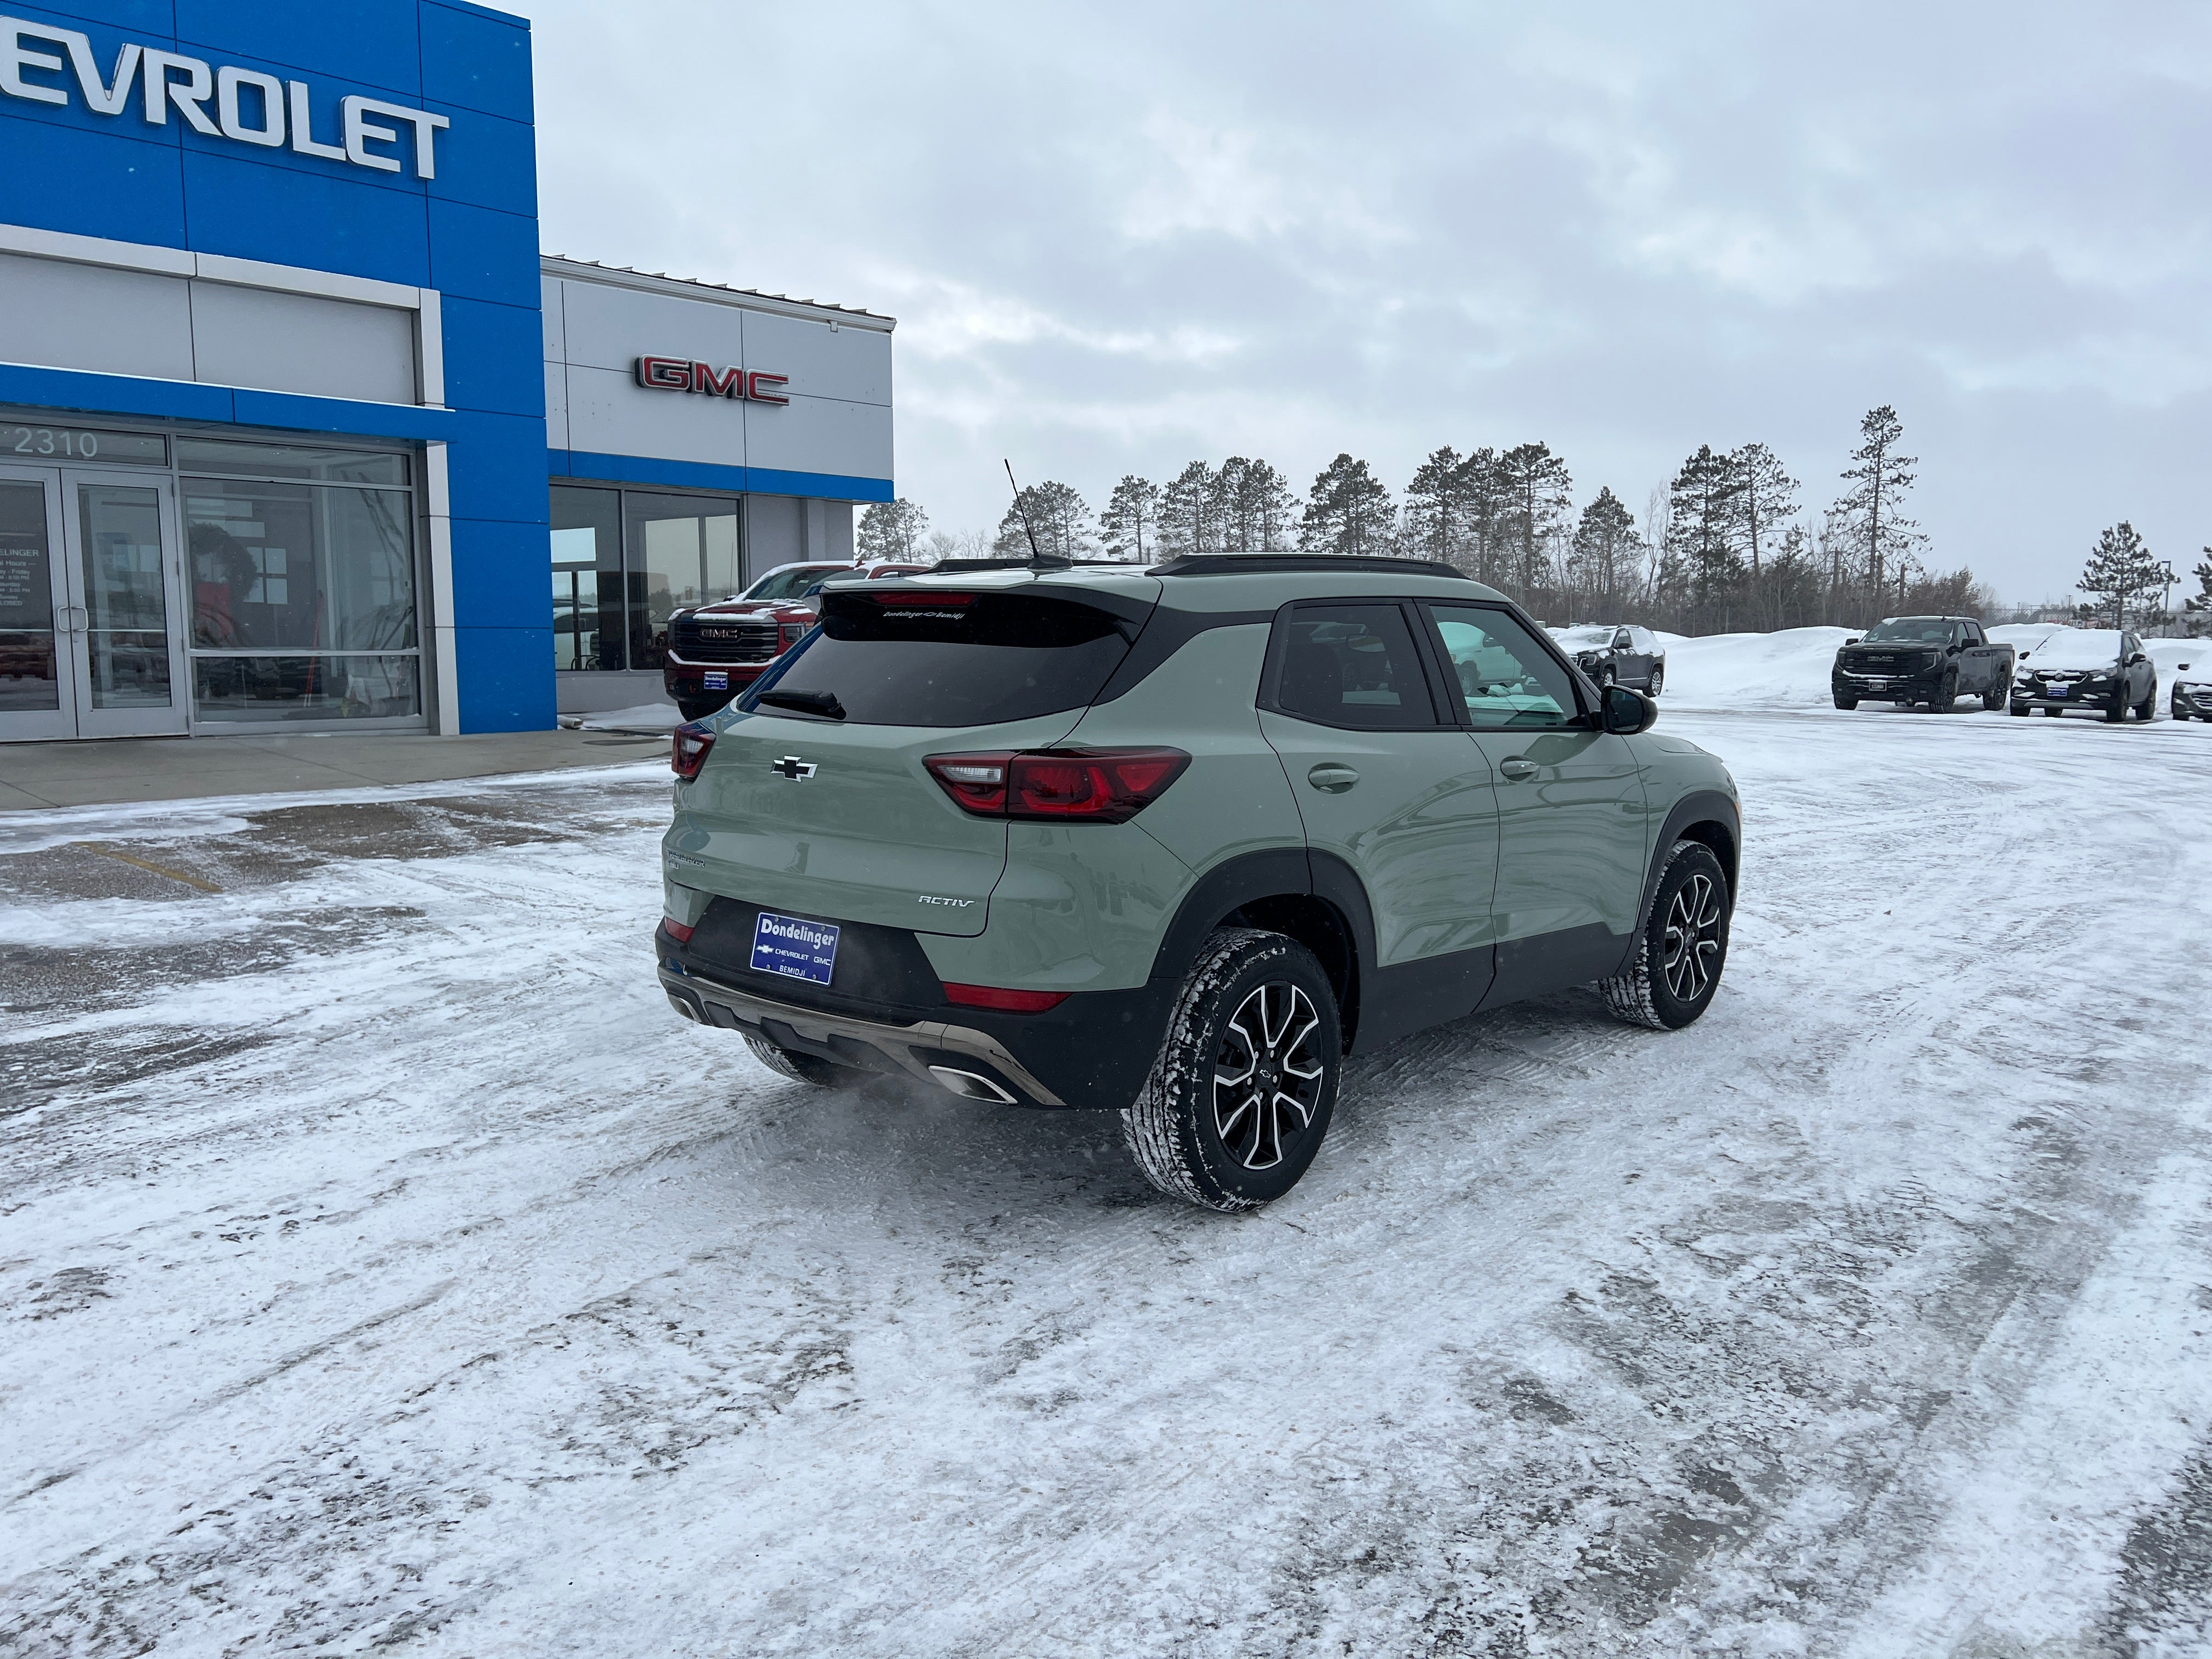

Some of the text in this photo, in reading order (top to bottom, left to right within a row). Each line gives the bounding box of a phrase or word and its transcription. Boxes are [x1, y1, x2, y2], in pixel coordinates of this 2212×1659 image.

[0, 15, 450, 179] EVROLET
[635, 353, 789, 406] GMC
[15, 427, 98, 457] 2310
[700, 629, 737, 638] GMC
[918, 895, 975, 907] ACTIV
[761, 918, 834, 950] Dondelinger
[775, 948, 832, 966] CHEVROLET GMC
[779, 964, 805, 977] BEMIDJI
